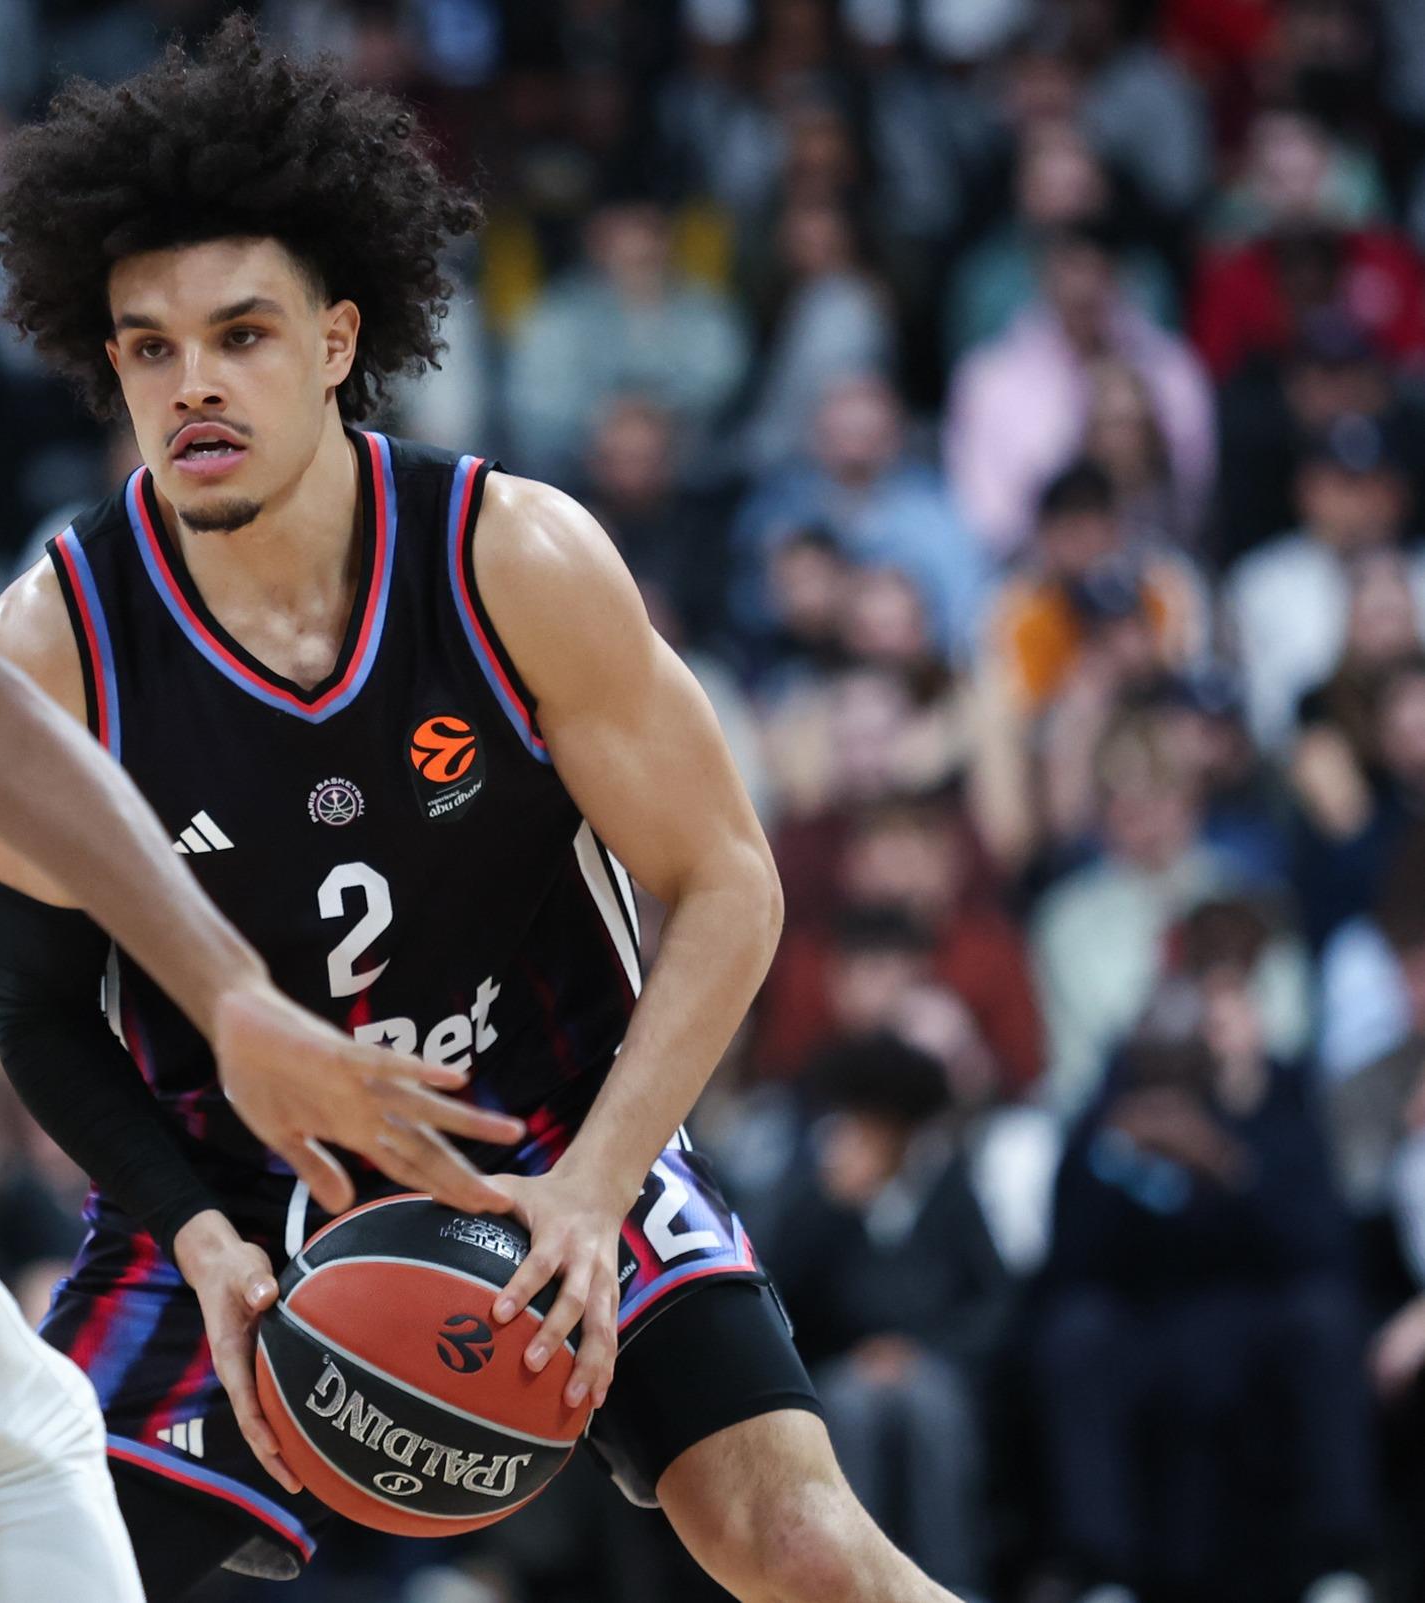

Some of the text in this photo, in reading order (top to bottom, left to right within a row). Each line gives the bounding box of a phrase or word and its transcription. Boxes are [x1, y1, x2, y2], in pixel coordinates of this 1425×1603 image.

[307, 777, 365, 823] PARIS BASKETBALL
[429, 780, 483, 818] abu dhabi
[317, 861, 394, 998] 2
[642, 1158, 722, 1263] 2
[305, 1361, 533, 1498] SPALDING
